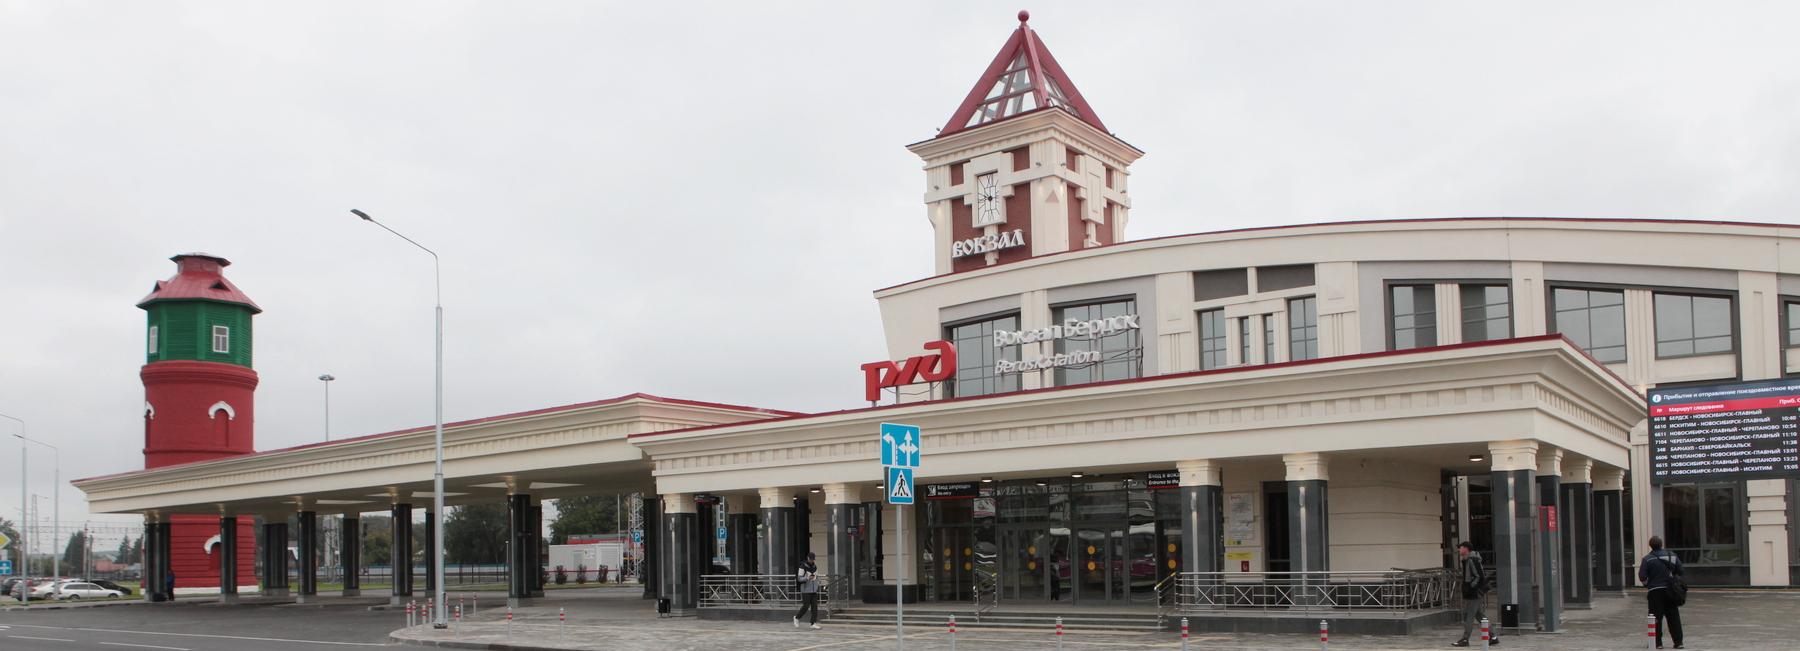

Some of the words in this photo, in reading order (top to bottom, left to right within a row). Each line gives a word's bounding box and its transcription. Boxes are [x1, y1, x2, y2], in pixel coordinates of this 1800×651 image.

[993, 325, 1063, 347] Вокзал
[1064, 314, 1140, 339] Бердск
[1692, 410, 1762, 419] НОВОСИБИРСК-ГЛАВНЫЙ
[1700, 416, 1770, 426] НОВОСИБИРСК-ГЛАВНЫЙ
[1670, 427, 1738, 436] НОВОСИБИРСК-ГЛАВНЫЙ
[1710, 432, 1780, 442] НОВОСИБИРСК-ГЛАВНЫЙ
[1710, 448, 1781, 458] НОВОСИБИРСК-ГЛАВНЫЙ
[1671, 459, 1739, 467] НОВОСИБИРСК-ГЛАВНЫЙ
[1671, 467, 1740, 475] НОВОСИБИРСК-ГЛАВНЫЙ
[720, 528, 724, 538] P
